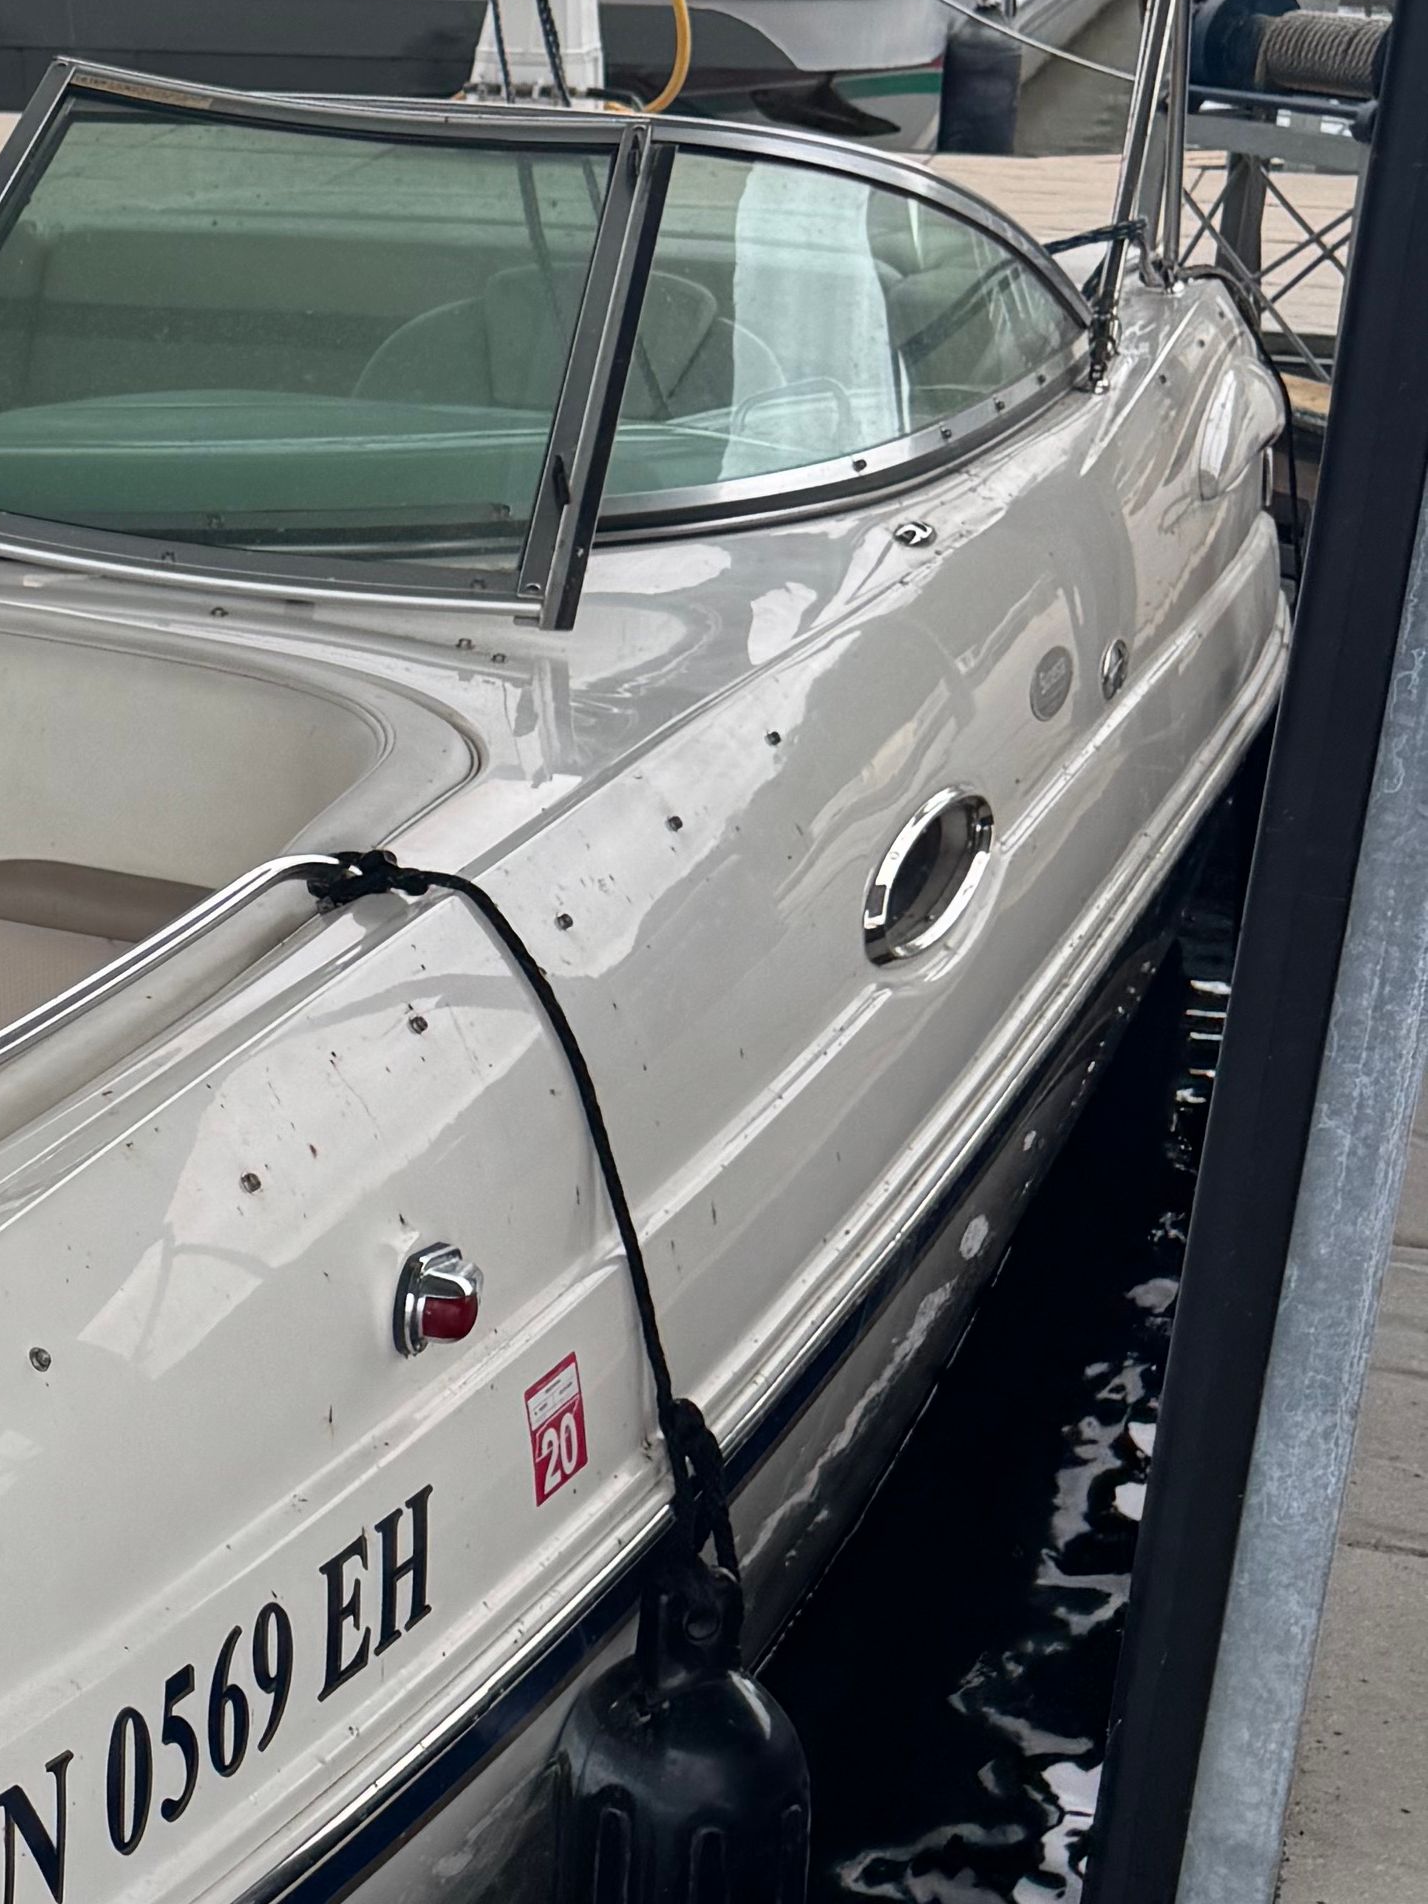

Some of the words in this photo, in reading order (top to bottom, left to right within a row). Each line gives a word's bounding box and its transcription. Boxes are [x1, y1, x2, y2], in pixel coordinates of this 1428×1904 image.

[541, 1412, 578, 1495] 20
[106, 1602, 293, 1856] 0569
[319, 1484, 434, 1703] EH
